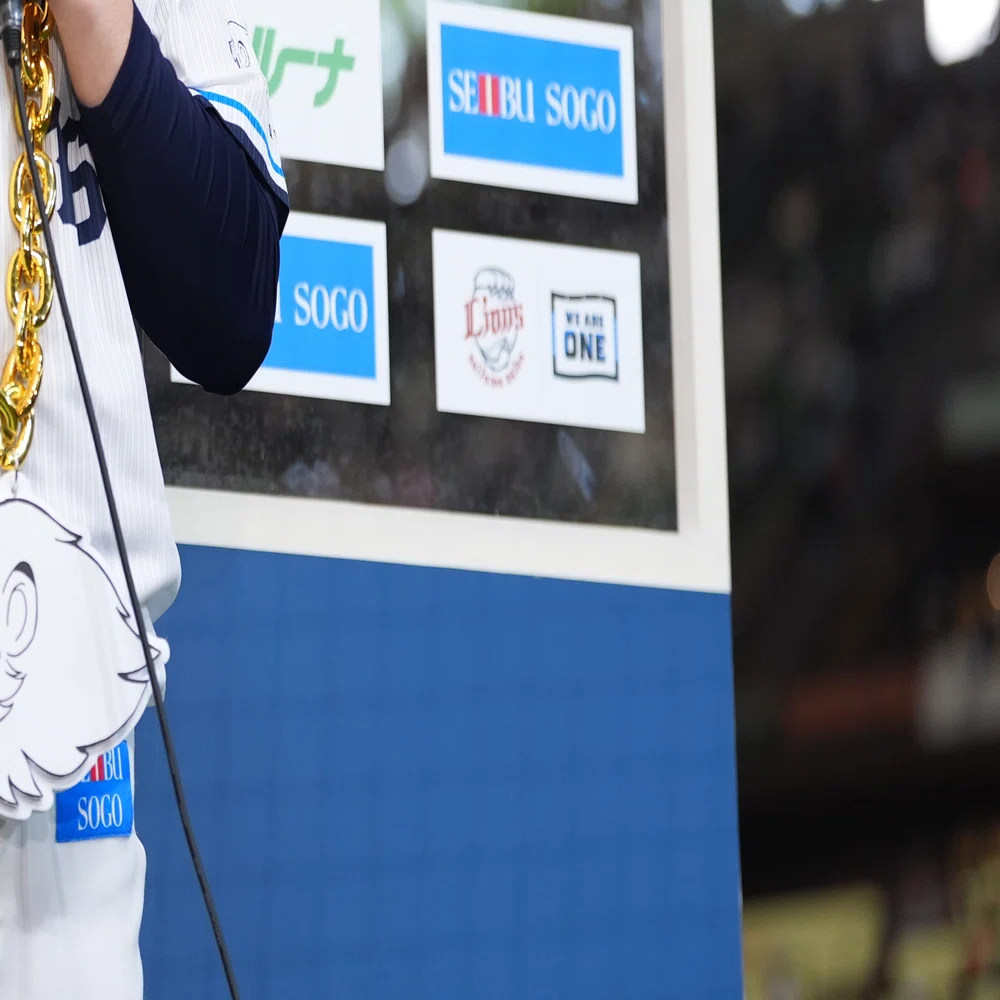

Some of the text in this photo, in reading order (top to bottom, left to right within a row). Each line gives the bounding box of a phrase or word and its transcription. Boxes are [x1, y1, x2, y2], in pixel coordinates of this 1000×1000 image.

[448, 68, 617, 135] SEIBU SOGO
[293, 283, 368, 334] SOGO
[464, 297, 524, 340] Lions
[566, 311, 604, 328] WE ARE
[564, 331, 606, 362] ONE
[77, 793, 123, 831] SOGO
